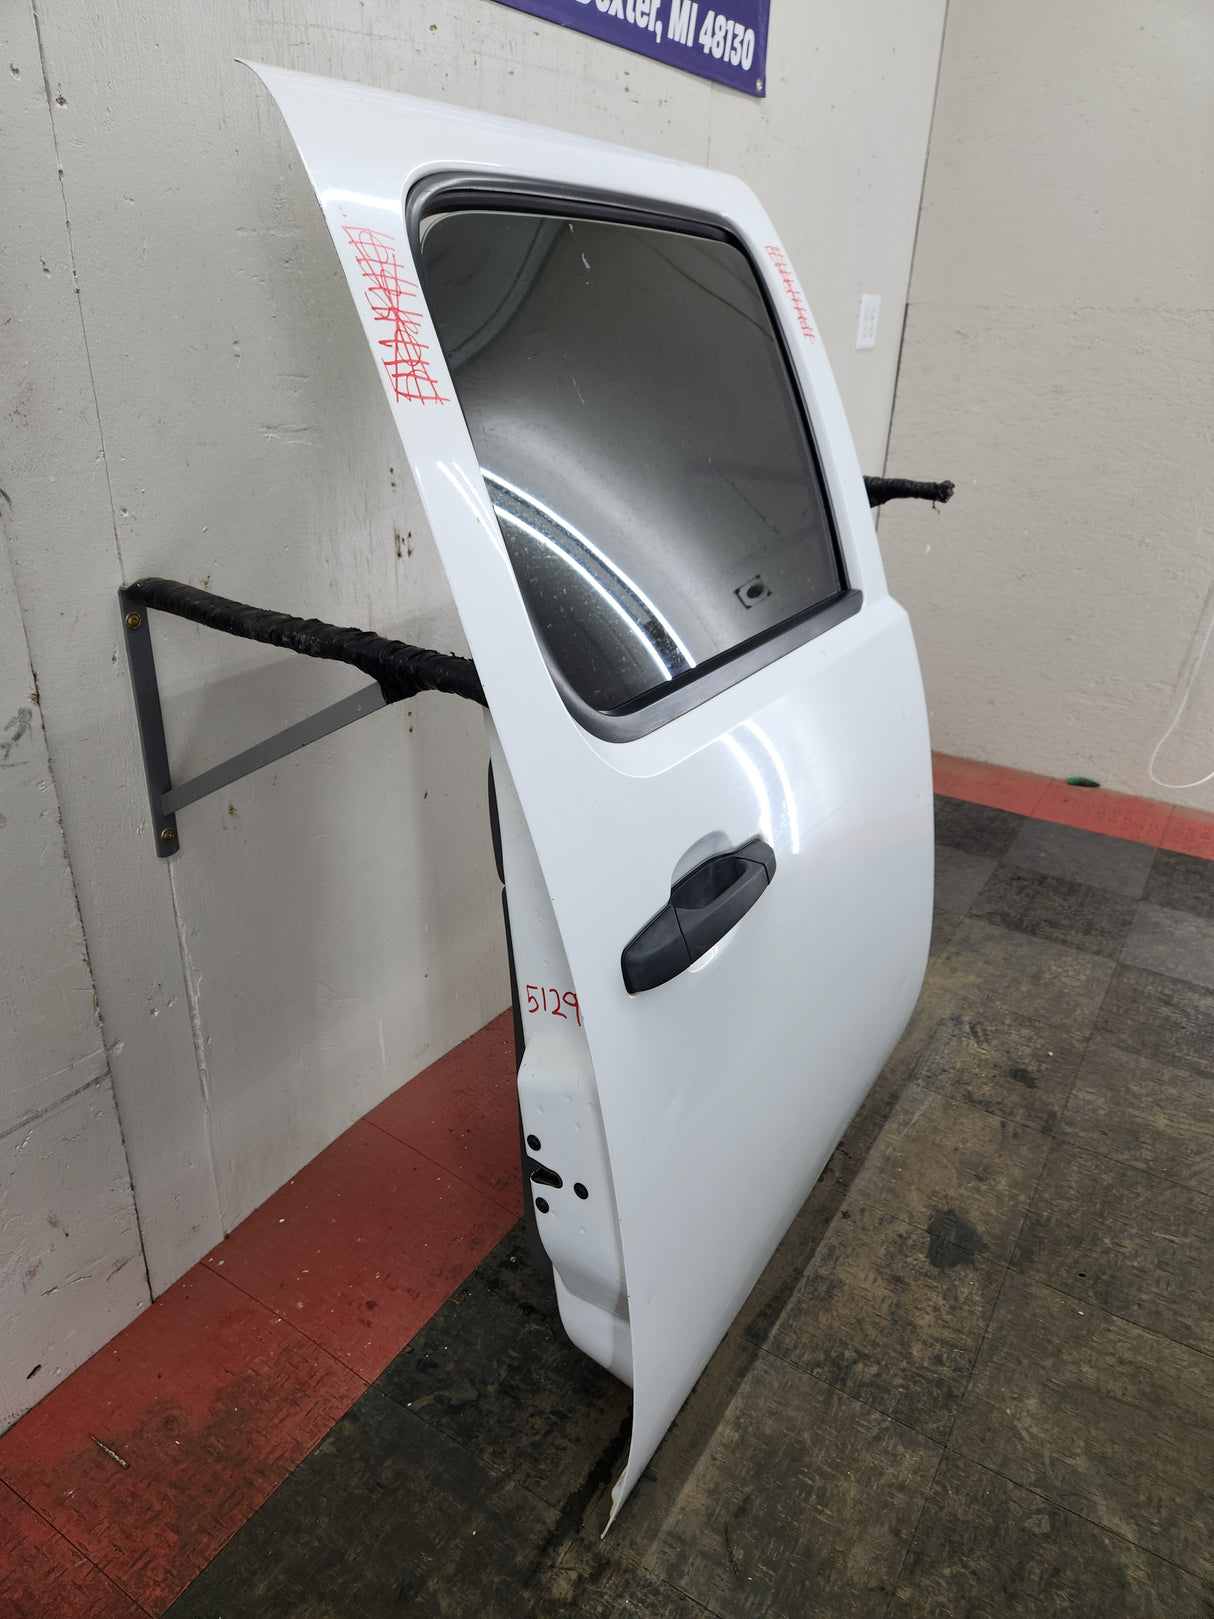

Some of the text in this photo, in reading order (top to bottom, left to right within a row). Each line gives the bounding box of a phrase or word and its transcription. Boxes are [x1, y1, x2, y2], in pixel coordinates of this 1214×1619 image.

[575, 0, 755, 70] xter, MI 48130
[526, 984, 581, 1027] 5129
